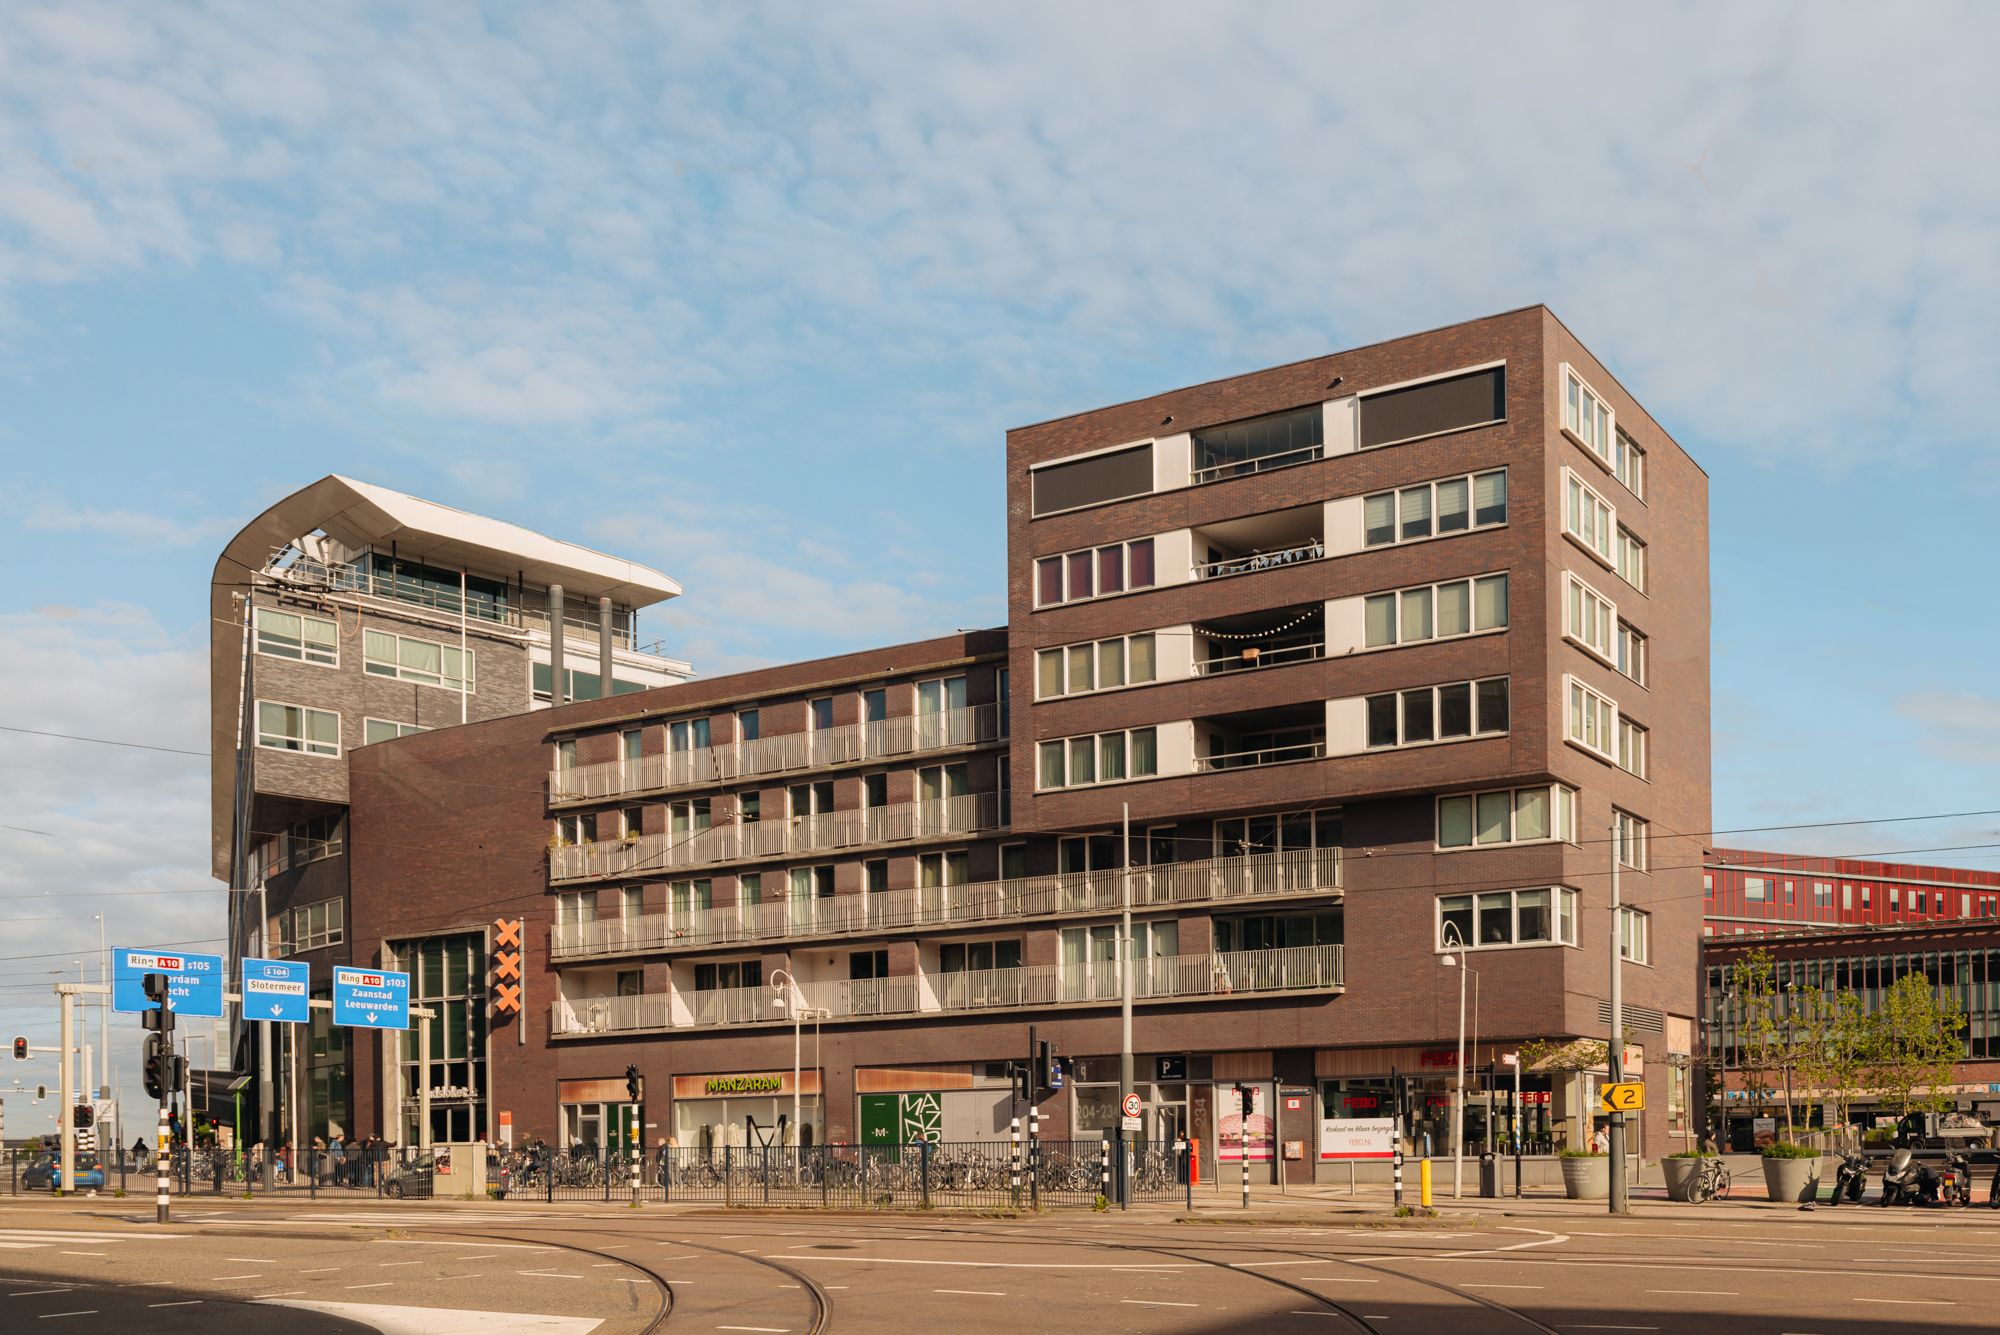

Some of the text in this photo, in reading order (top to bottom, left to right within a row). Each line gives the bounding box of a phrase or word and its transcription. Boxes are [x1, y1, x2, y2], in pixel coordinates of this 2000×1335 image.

[131, 956, 154, 967] Ring
[159, 959, 178, 967] A10
[273, 968, 287, 976] 104
[168, 975, 200, 985] erdam
[341, 974, 360, 984] Ring
[363, 977, 380, 985] A10
[168, 987, 190, 996] echt
[251, 981, 302, 992] Slotermeer
[352, 988, 393, 1000] Zaanstad
[345, 999, 399, 1012] Leeuwarden
[708, 1077, 782, 1091] MANZARAM
[1623, 1089, 1636, 1105] 2
[1127, 1101, 1139, 1111] 30
[1343, 1097, 1377, 1109] FEBO
